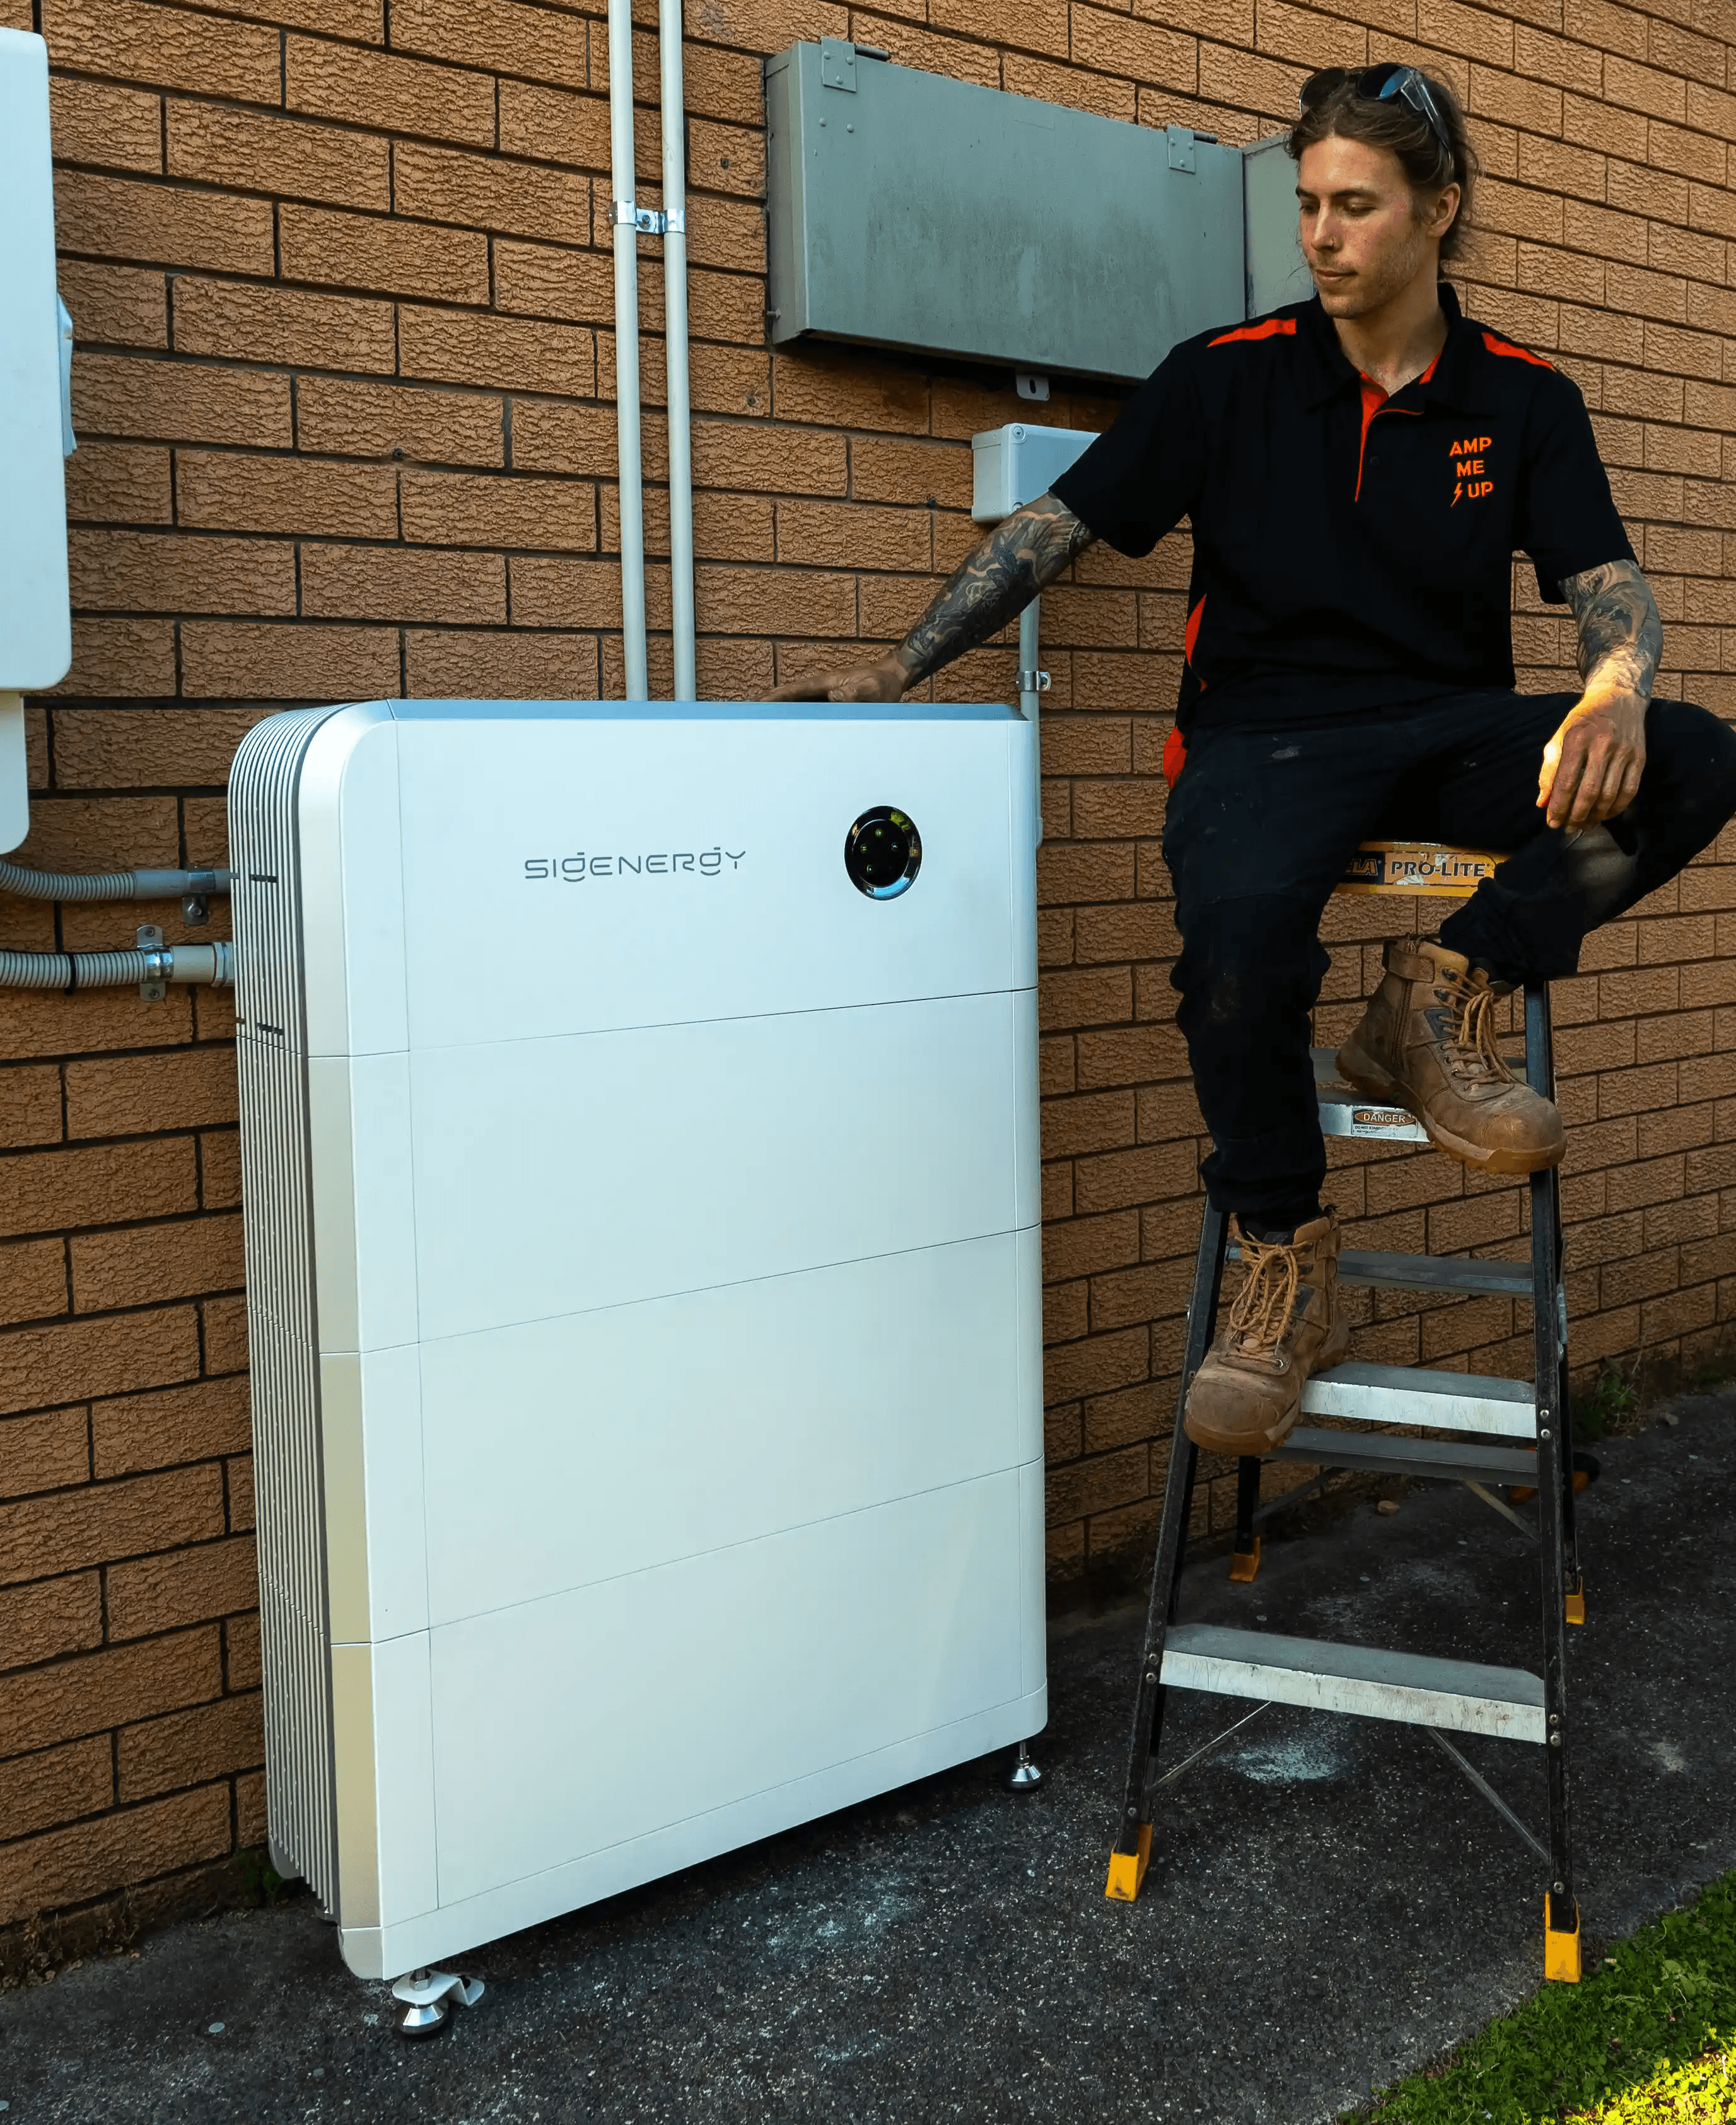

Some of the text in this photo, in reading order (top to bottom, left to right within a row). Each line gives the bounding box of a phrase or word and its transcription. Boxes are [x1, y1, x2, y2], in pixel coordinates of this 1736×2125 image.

[1449, 437, 1492, 457] AMP
[1457, 460, 1484, 477] ME
[1468, 481, 1494, 498] UP
[1391, 860, 1486, 877] PRO-LITE
[1363, 1113, 1406, 1123] DANGER
